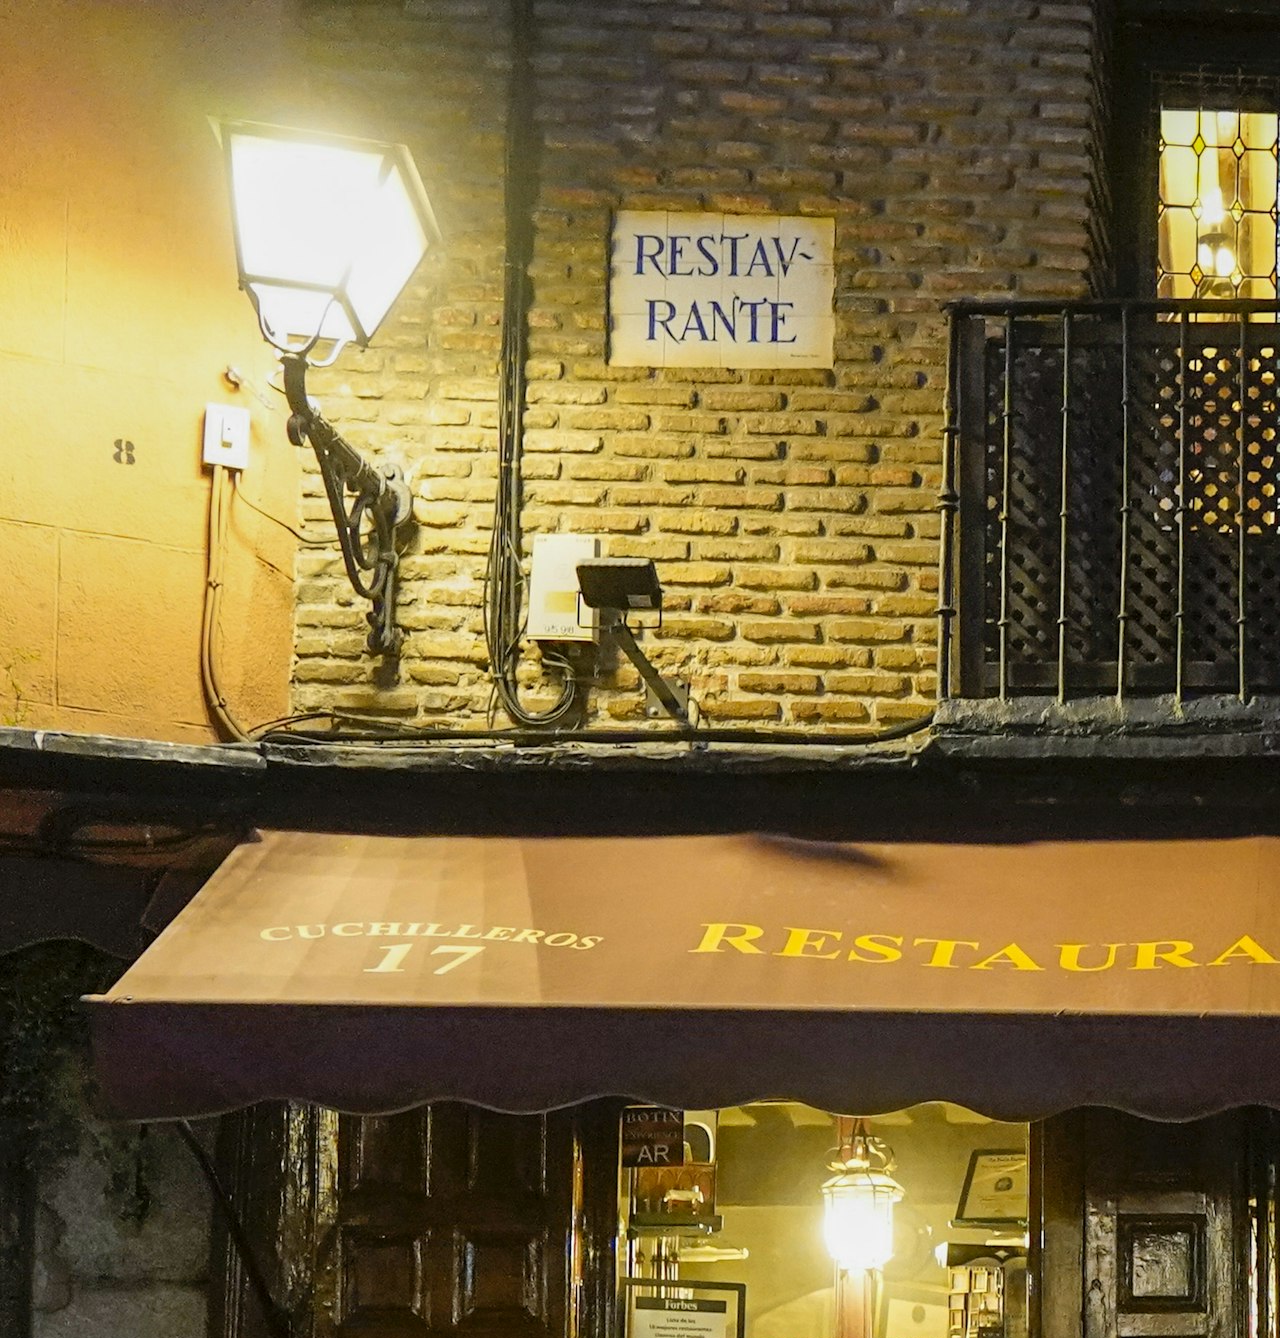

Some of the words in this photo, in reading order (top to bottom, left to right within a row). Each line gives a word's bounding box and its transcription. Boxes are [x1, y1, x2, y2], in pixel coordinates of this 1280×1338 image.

[645, 292, 797, 344] RANTE
[112, 438, 136, 465] 8
[260, 921, 604, 951] CUCHILLEROS
[363, 943, 486, 976] 17
[637, 1144, 671, 1163] AR
[664, 1299, 698, 1311] Forbes
